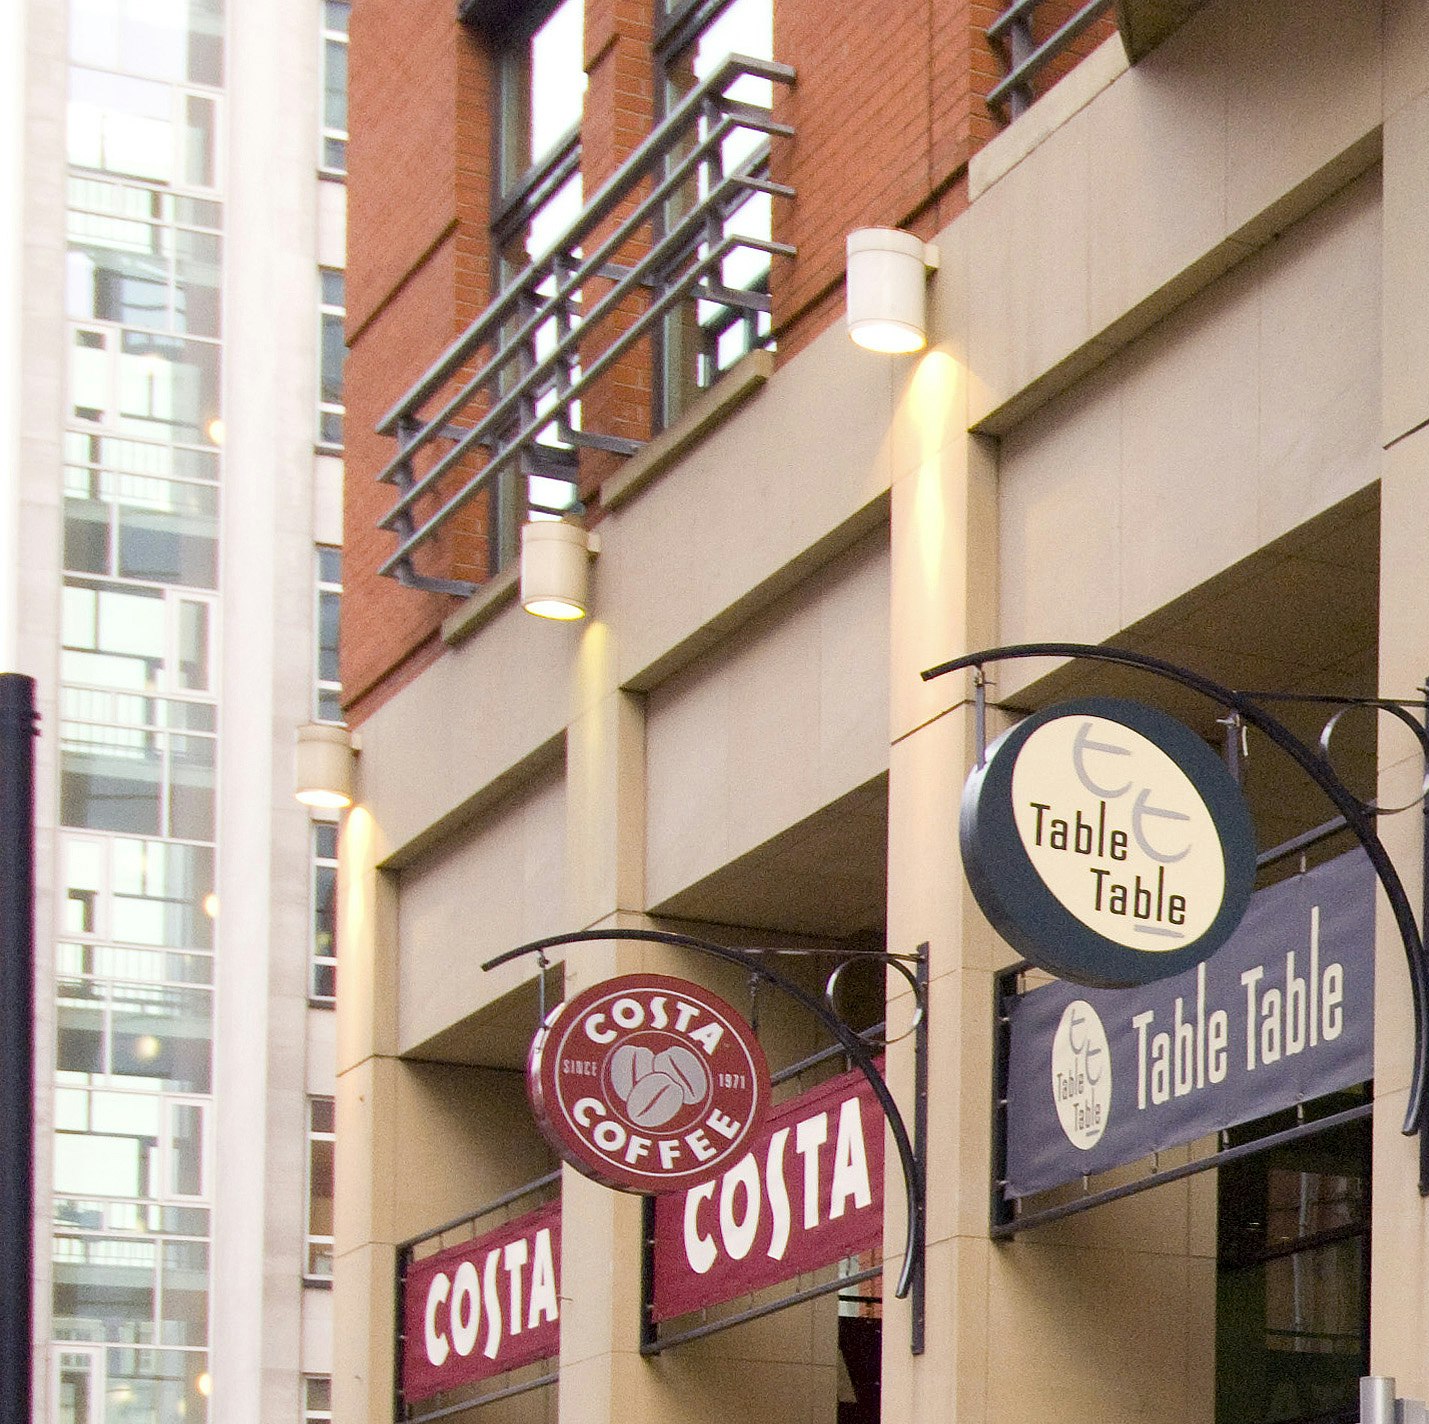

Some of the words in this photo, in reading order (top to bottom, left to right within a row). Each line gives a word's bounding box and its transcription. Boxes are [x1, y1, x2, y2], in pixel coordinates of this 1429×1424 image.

[1030, 800, 1128, 861] Table
[1090, 866, 1186, 925] Table
[585, 996, 724, 1056] COSTA
[1132, 961, 1228, 1110] Table
[1241, 905, 1343, 1071] Table
[563, 1059, 597, 1076] SINCE
[718, 1073, 746, 1089] 1971
[573, 1097, 741, 1170] COFFEE
[683, 1096, 872, 1275] COSTA
[424, 1228, 559, 1367] COSTA
